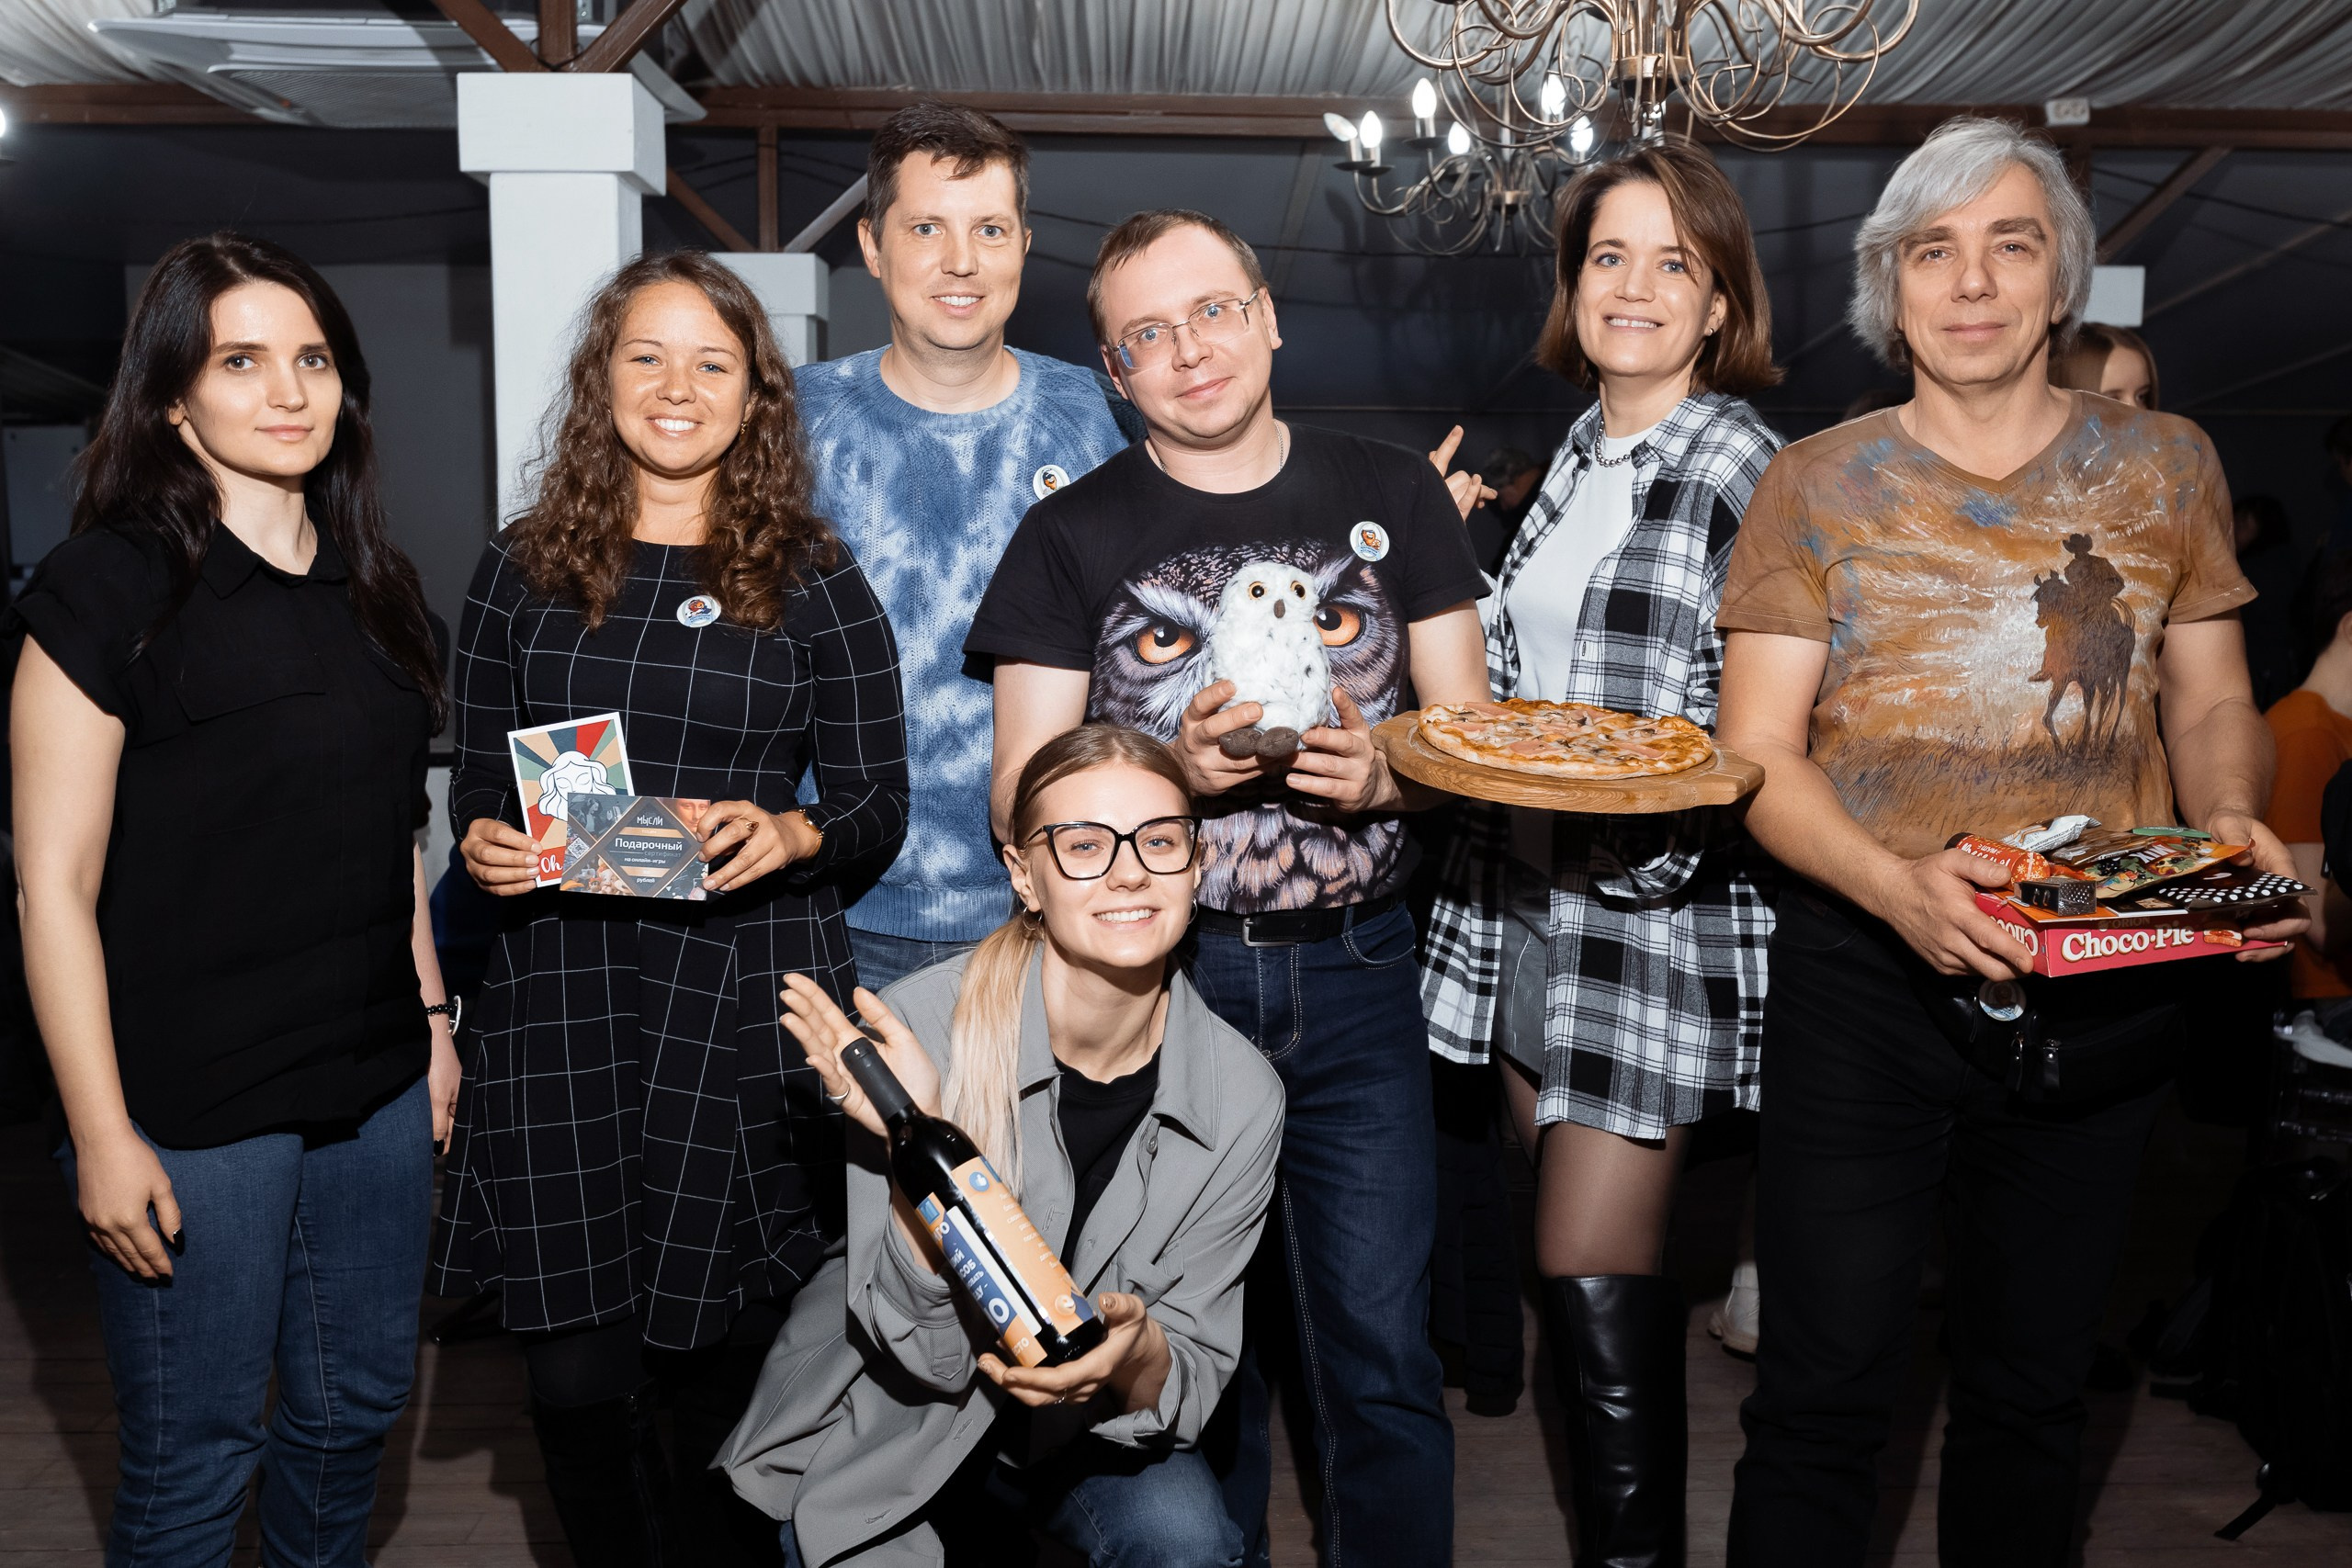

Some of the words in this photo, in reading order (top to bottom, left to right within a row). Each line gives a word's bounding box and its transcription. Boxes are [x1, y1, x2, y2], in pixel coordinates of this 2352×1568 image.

[615, 838, 683, 852] Подарочный
[540, 854, 563, 874] Oh
[2112, 917, 2151, 929] ORION
[959, 1258, 977, 1278] СОБ
